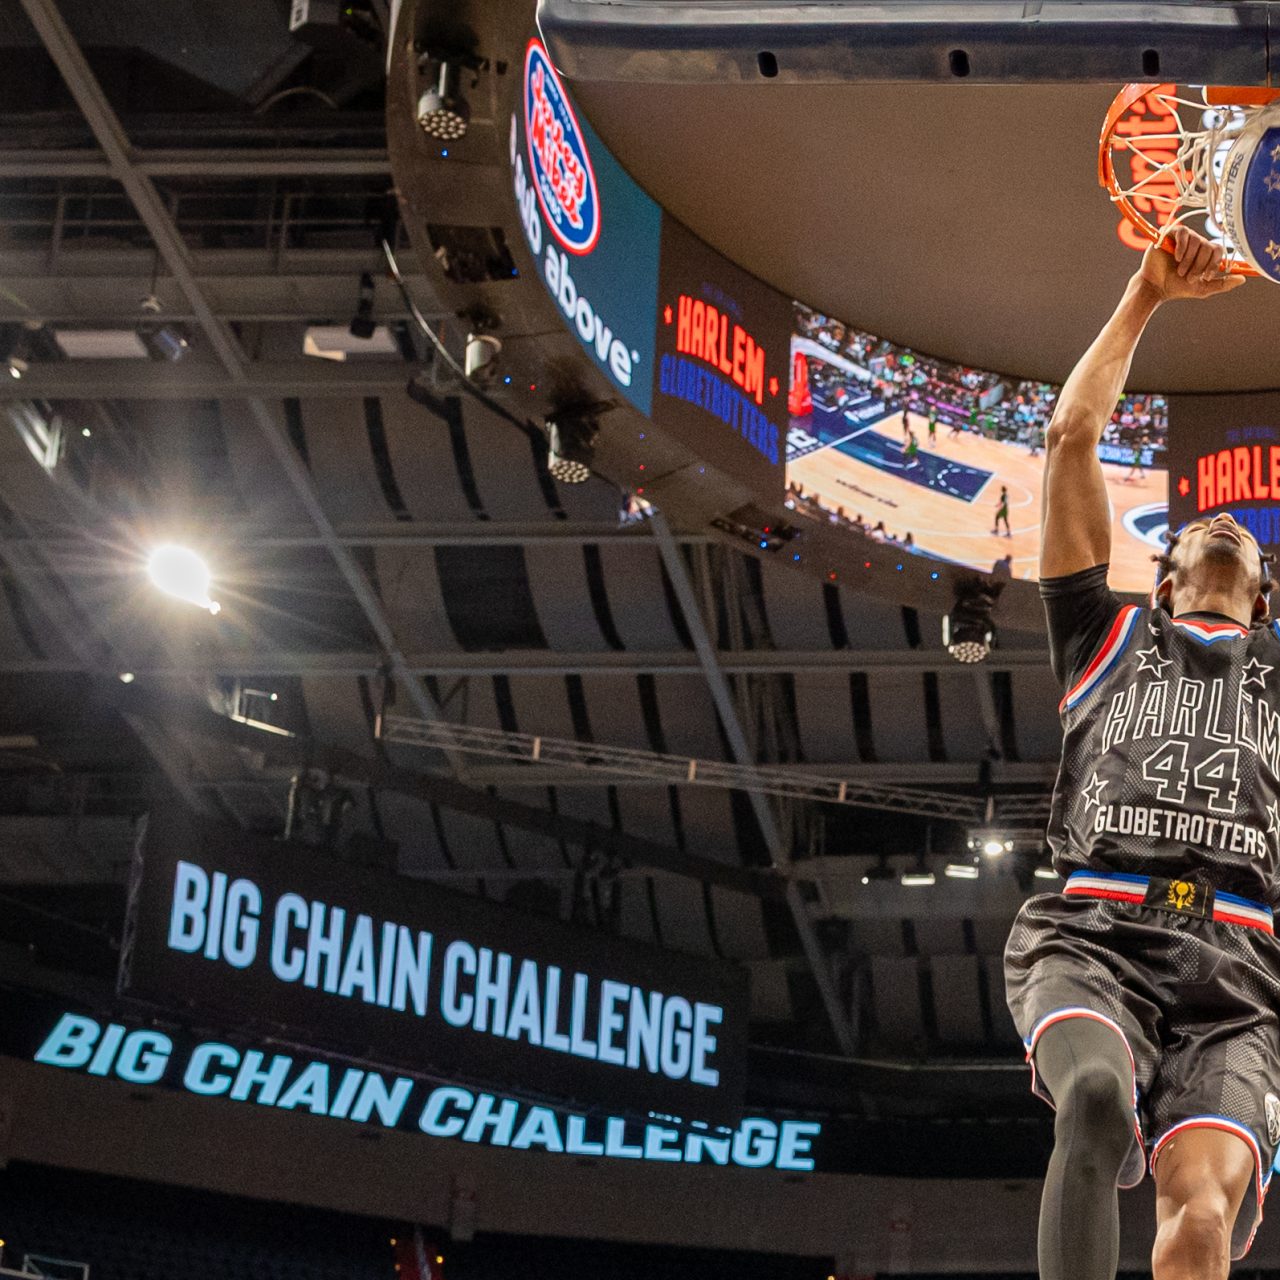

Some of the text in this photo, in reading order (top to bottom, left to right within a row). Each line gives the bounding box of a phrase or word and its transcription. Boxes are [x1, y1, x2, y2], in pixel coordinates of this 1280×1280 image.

[544, 244, 634, 388] above
[676, 294, 766, 406] HARLEM
[660, 352, 780, 466] GLOBETROTTERS
[1094, 805, 1267, 860] GLOBETROTTERS
[1142, 740, 1241, 814] 44
[167, 860, 723, 1087] BIG CHAIN CHALLENGE
[34, 1012, 172, 1084] BIG
[182, 1041, 413, 1128] CHAIN
